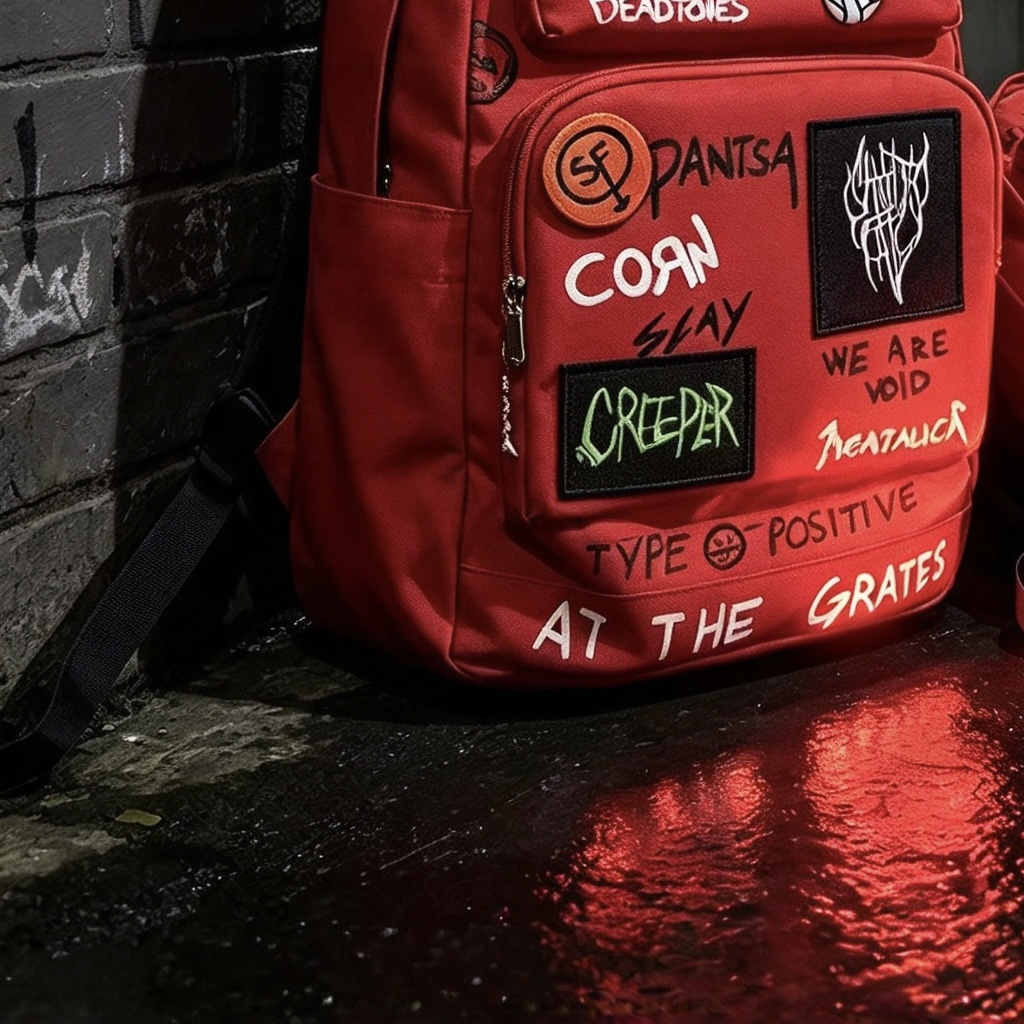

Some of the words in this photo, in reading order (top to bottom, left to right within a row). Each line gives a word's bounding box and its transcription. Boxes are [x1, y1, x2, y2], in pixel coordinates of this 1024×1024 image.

[821, 339, 870, 377] WE
[887, 328, 949, 366] ARE
[864, 369, 931, 405] VOID
[574, 381, 741, 468] CREEPER
[585, 532, 691, 580] TYPE
[531, 599, 608, 661] AT
[650, 595, 764, 662] THE
[806, 538, 948, 630] GRATES
